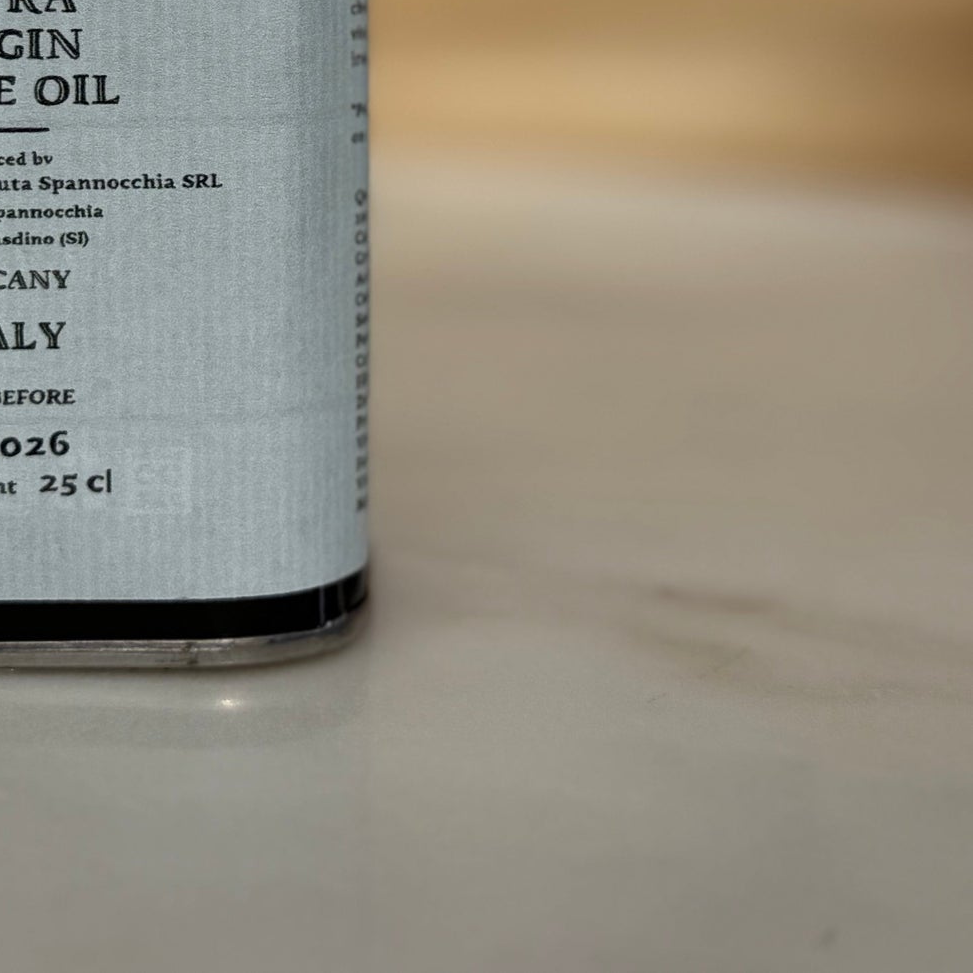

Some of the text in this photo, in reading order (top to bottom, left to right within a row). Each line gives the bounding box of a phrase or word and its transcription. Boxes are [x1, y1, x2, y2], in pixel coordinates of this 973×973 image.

[34, 74, 120, 106] OIL
[38, 173, 176, 196] Spannocchia
[182, 173, 224, 190] SRL
[60, 231, 89, 248] (SI)
[39, 473, 78, 496] 25
[86, 469, 112, 493] cl
